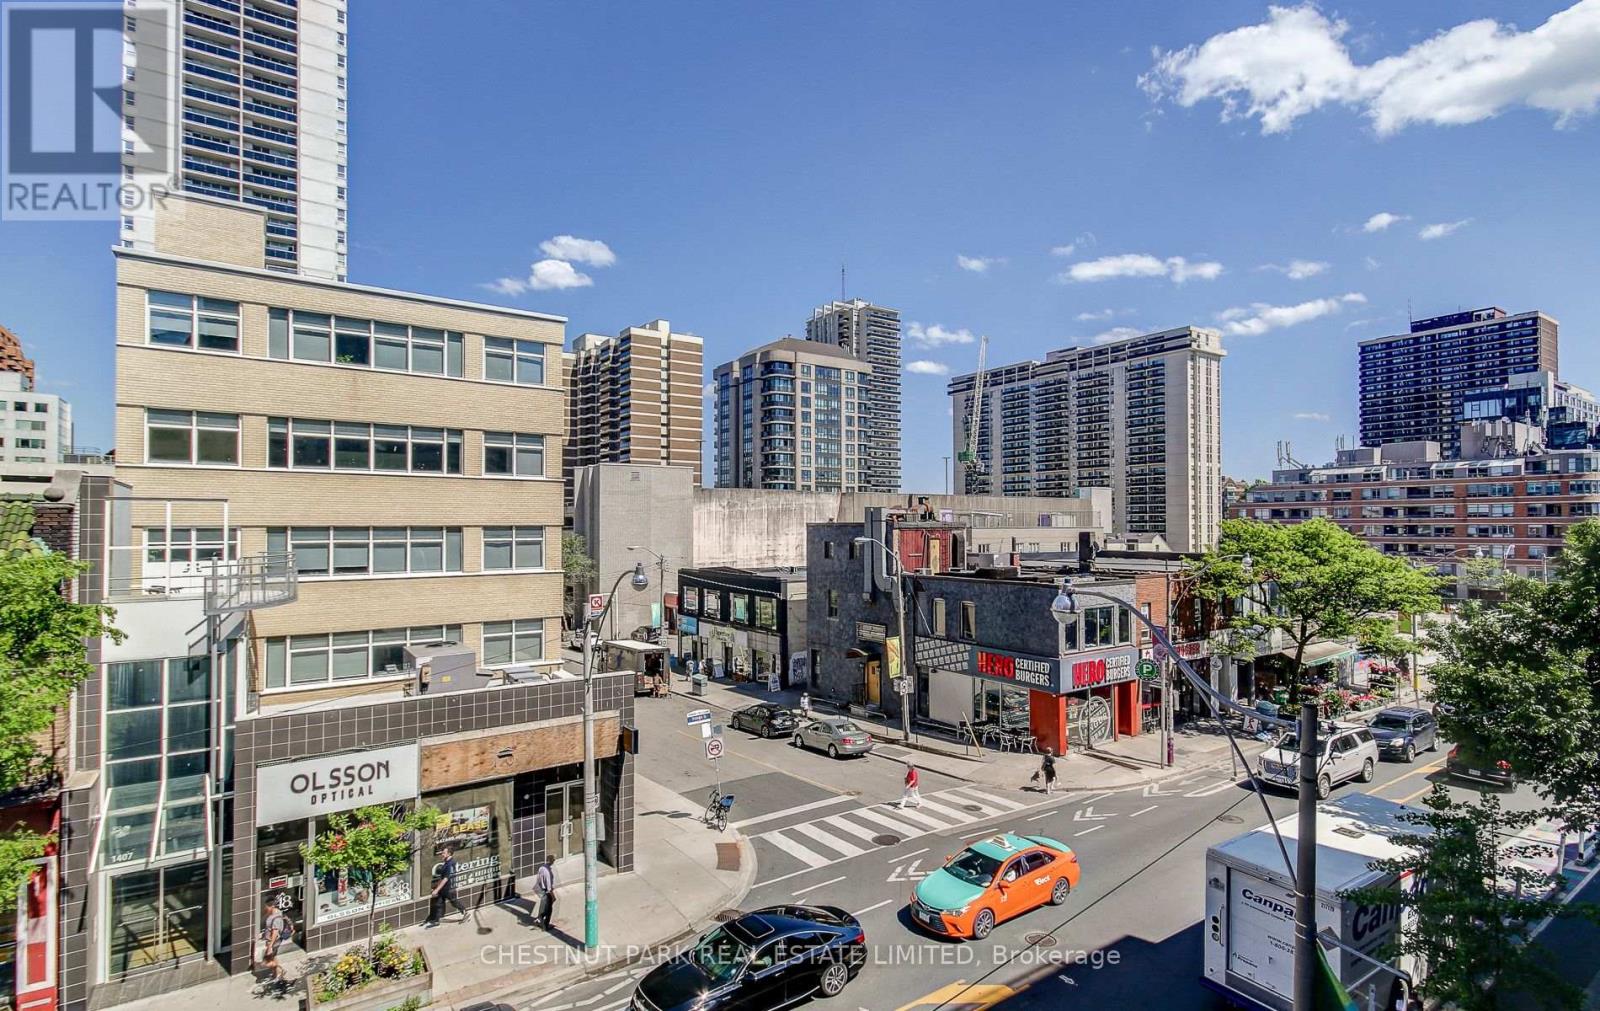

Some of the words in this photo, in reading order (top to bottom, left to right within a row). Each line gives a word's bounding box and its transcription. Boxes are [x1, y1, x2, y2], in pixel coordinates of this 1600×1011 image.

[977, 651, 1015, 679] HERO
[1015, 657, 1050, 674] CERTIFIED
[1072, 659, 1105, 687] HERO
[1015, 669, 1050, 687] BURGERS
[290, 760, 390, 794] OLSSON
[311, 786, 373, 805] OPTICAL
[112, 852, 134, 863] 1407
[1242, 888, 1296, 917] Canpa
